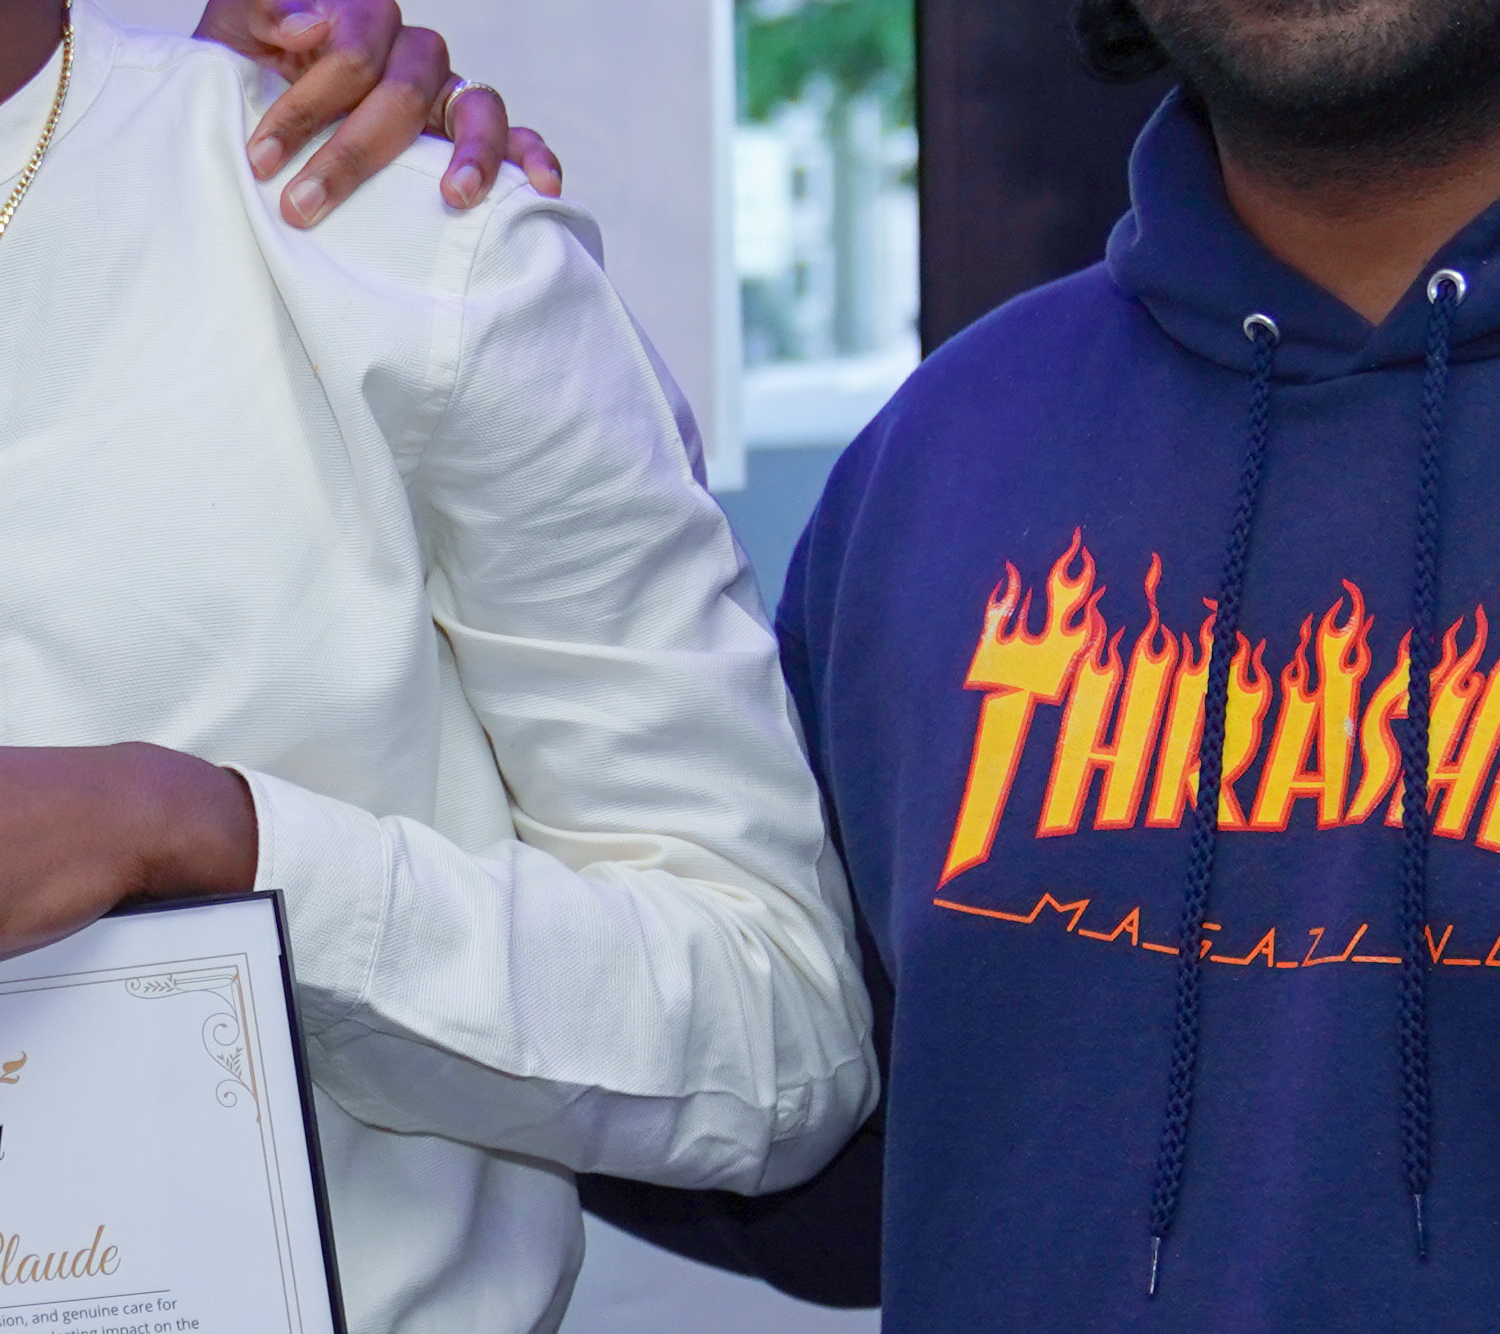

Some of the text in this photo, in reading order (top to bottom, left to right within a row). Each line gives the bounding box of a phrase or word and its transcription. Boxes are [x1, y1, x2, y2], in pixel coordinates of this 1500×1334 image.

[32, 1309, 59, 1326] and
[62, 1305, 119, 1325] genuine
[123, 1300, 154, 1316] care
[157, 1297, 178, 1312] for
[154, 1320, 174, 1334] on
[176, 1317, 200, 1331] the
